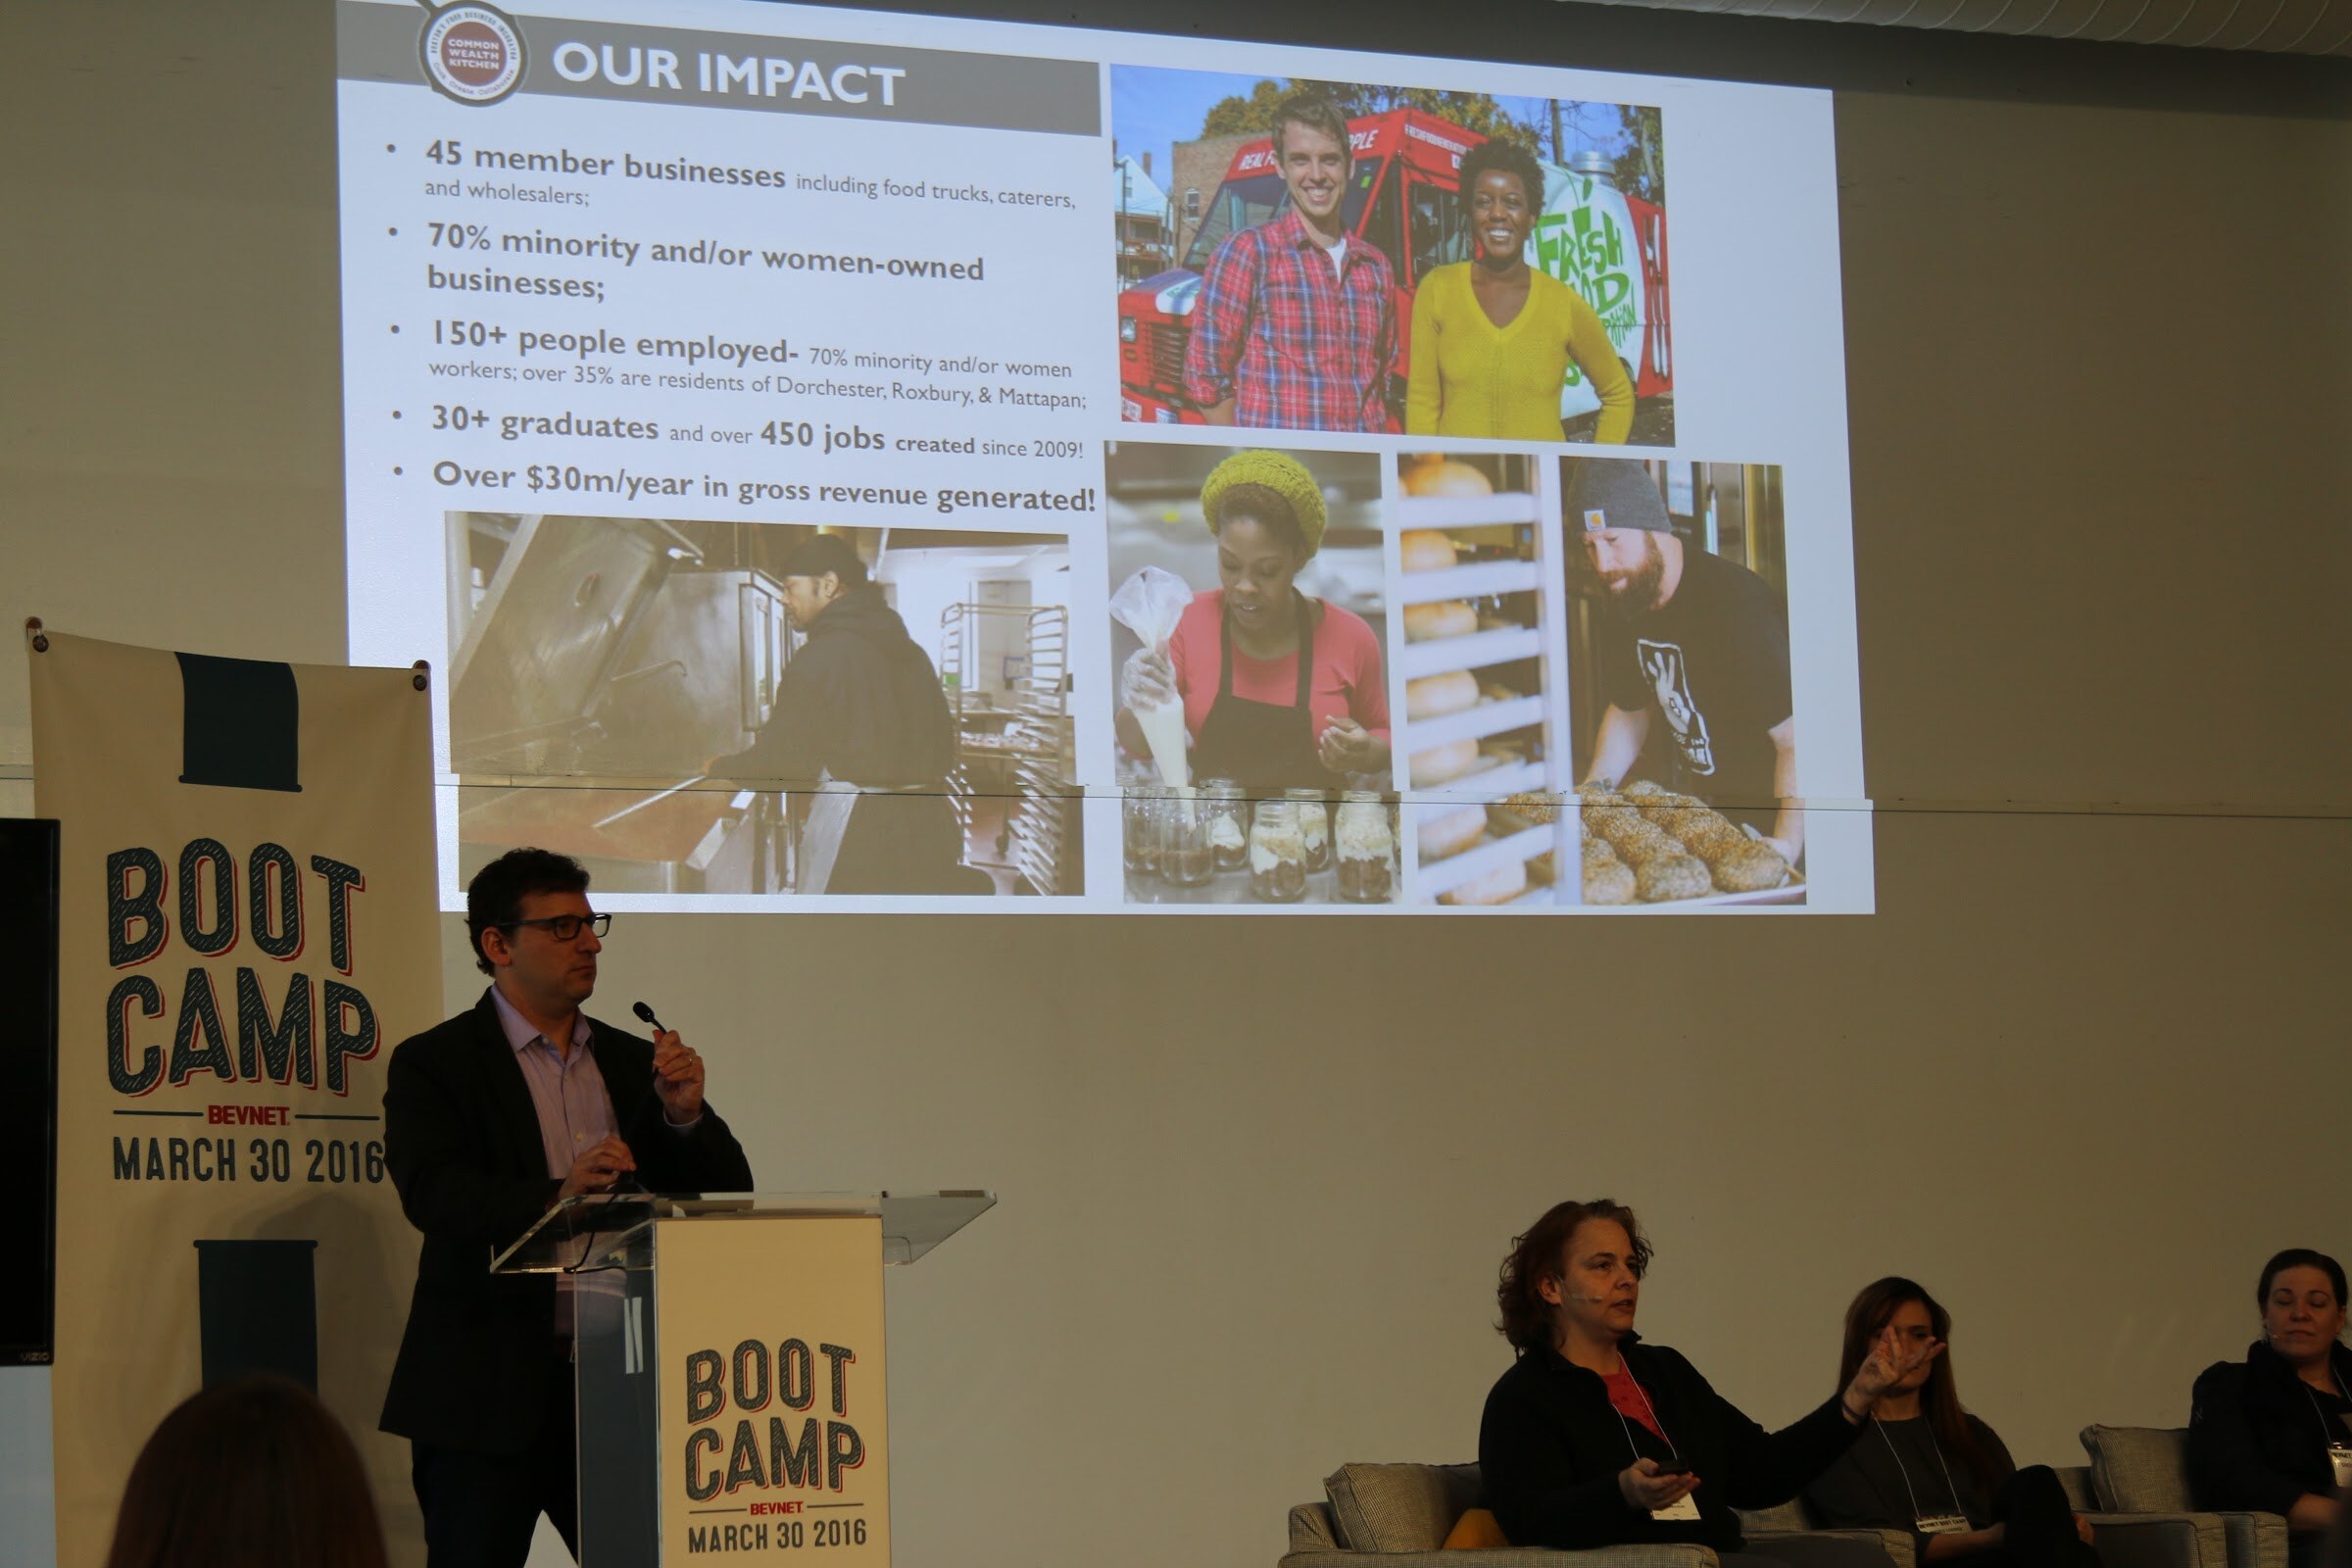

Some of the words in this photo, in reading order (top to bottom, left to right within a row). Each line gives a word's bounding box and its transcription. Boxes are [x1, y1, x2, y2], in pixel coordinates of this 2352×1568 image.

[448, 38, 500, 50] COMMON
[449, 49, 500, 61] WEALTH
[449, 58, 500, 70] KITCHEN
[553, 41, 683, 90] OUR
[699, 55, 906, 106] IMPACT
[425, 139, 463, 166] 45
[474, 149, 615, 175] member
[624, 153, 786, 188] businesses
[796, 173, 878, 199] including
[883, 179, 925, 198] food
[932, 184, 994, 205] trucks,
[998, 191, 1076, 210] caterers,
[425, 180, 461, 197] and
[467, 182, 590, 207] wholesalers;
[428, 222, 491, 251] 70%
[502, 229, 641, 267] minority
[651, 240, 753, 269] and/or
[762, 249, 985, 281] women-owned
[428, 264, 606, 304] businesses;
[435, 319, 508, 347] 150+
[519, 329, 626, 360] people
[637, 335, 800, 368] employed-
[808, 348, 849, 368] 70%
[855, 351, 932, 375] minority
[939, 356, 999, 374] and/or
[1005, 362, 1072, 377] women
[428, 361, 517, 382] workers;
[522, 367, 566, 382] over
[574, 366, 614, 385] 35%
[620, 372, 652, 387] are
[659, 371, 745, 392] residents
[752, 376, 772, 393] of
[777, 376, 887, 401] Dorchester,
[893, 382, 974, 408] Roxbury,
[979, 388, 993, 404] &
[999, 388, 1088, 412] Mattapan;
[432, 405, 490, 430] 30+
[501, 412, 660, 441] graduates
[669, 425, 704, 442] and
[710, 430, 753, 444] over
[760, 421, 813, 447] 450
[823, 423, 886, 455] jobs
[896, 437, 975, 455] created
[982, 441, 1028, 457] since
[1034, 441, 1084, 459] 2009!
[433, 461, 516, 488] Over
[526, 465, 694, 501] $30m/year
[704, 475, 728, 498] in
[739, 481, 810, 505] gross
[819, 484, 928, 506] revenue
[937, 487, 1097, 513] generated!
[106, 837, 366, 976] BOOT
[106, 967, 381, 1098] CAMP
[208, 1104, 291, 1126] BEVNET
[113, 1137, 236, 1182] MARCH
[250, 1139, 291, 1183] 30
[306, 1140, 385, 1184] 2016
[686, 1338, 857, 1426] BOOT
[685, 1417, 864, 1501] CAMP
[750, 1501, 804, 1516] BEVNET
[688, 1524, 768, 1553] MARCH
[777, 1522, 804, 1548] 30
[814, 1519, 867, 1547] 2016
